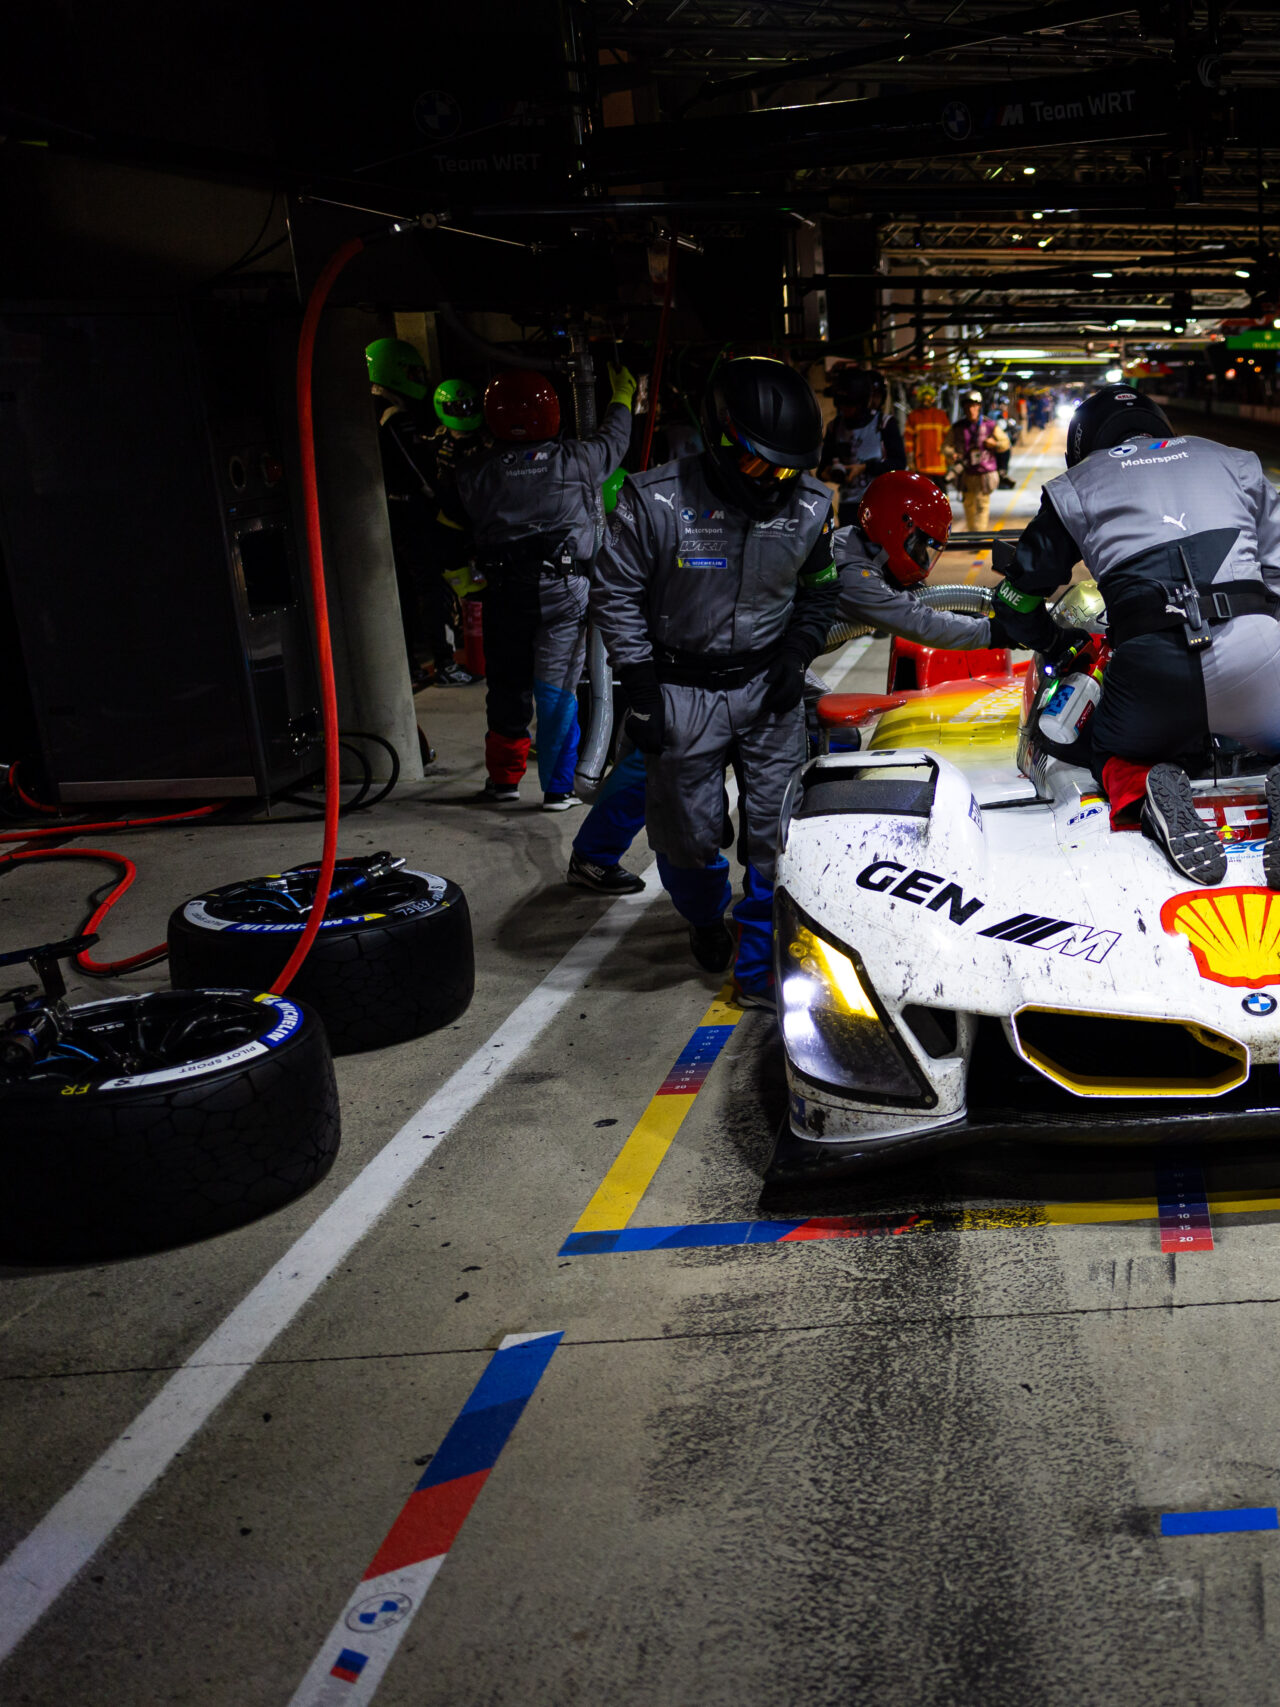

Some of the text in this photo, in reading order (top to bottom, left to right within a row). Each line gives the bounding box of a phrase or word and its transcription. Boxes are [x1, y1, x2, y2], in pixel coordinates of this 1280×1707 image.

[1029, 101, 1085, 123] Team
[1087, 89, 1137, 117] WRT
[431, 152, 542, 173] Team WRT
[1120, 451, 1189, 468] Motorsport
[505, 466, 548, 477] Motorsport
[684, 527, 724, 536] Motorsport
[754, 518, 800, 532] WEC
[1069, 808, 1100, 826] FIA
[856, 860, 985, 926] GEN
[265, 1002, 300, 1043] MICHELIN
[179, 1046, 256, 1074] PILOT SPORT
[60, 1084, 91, 1096] FR
